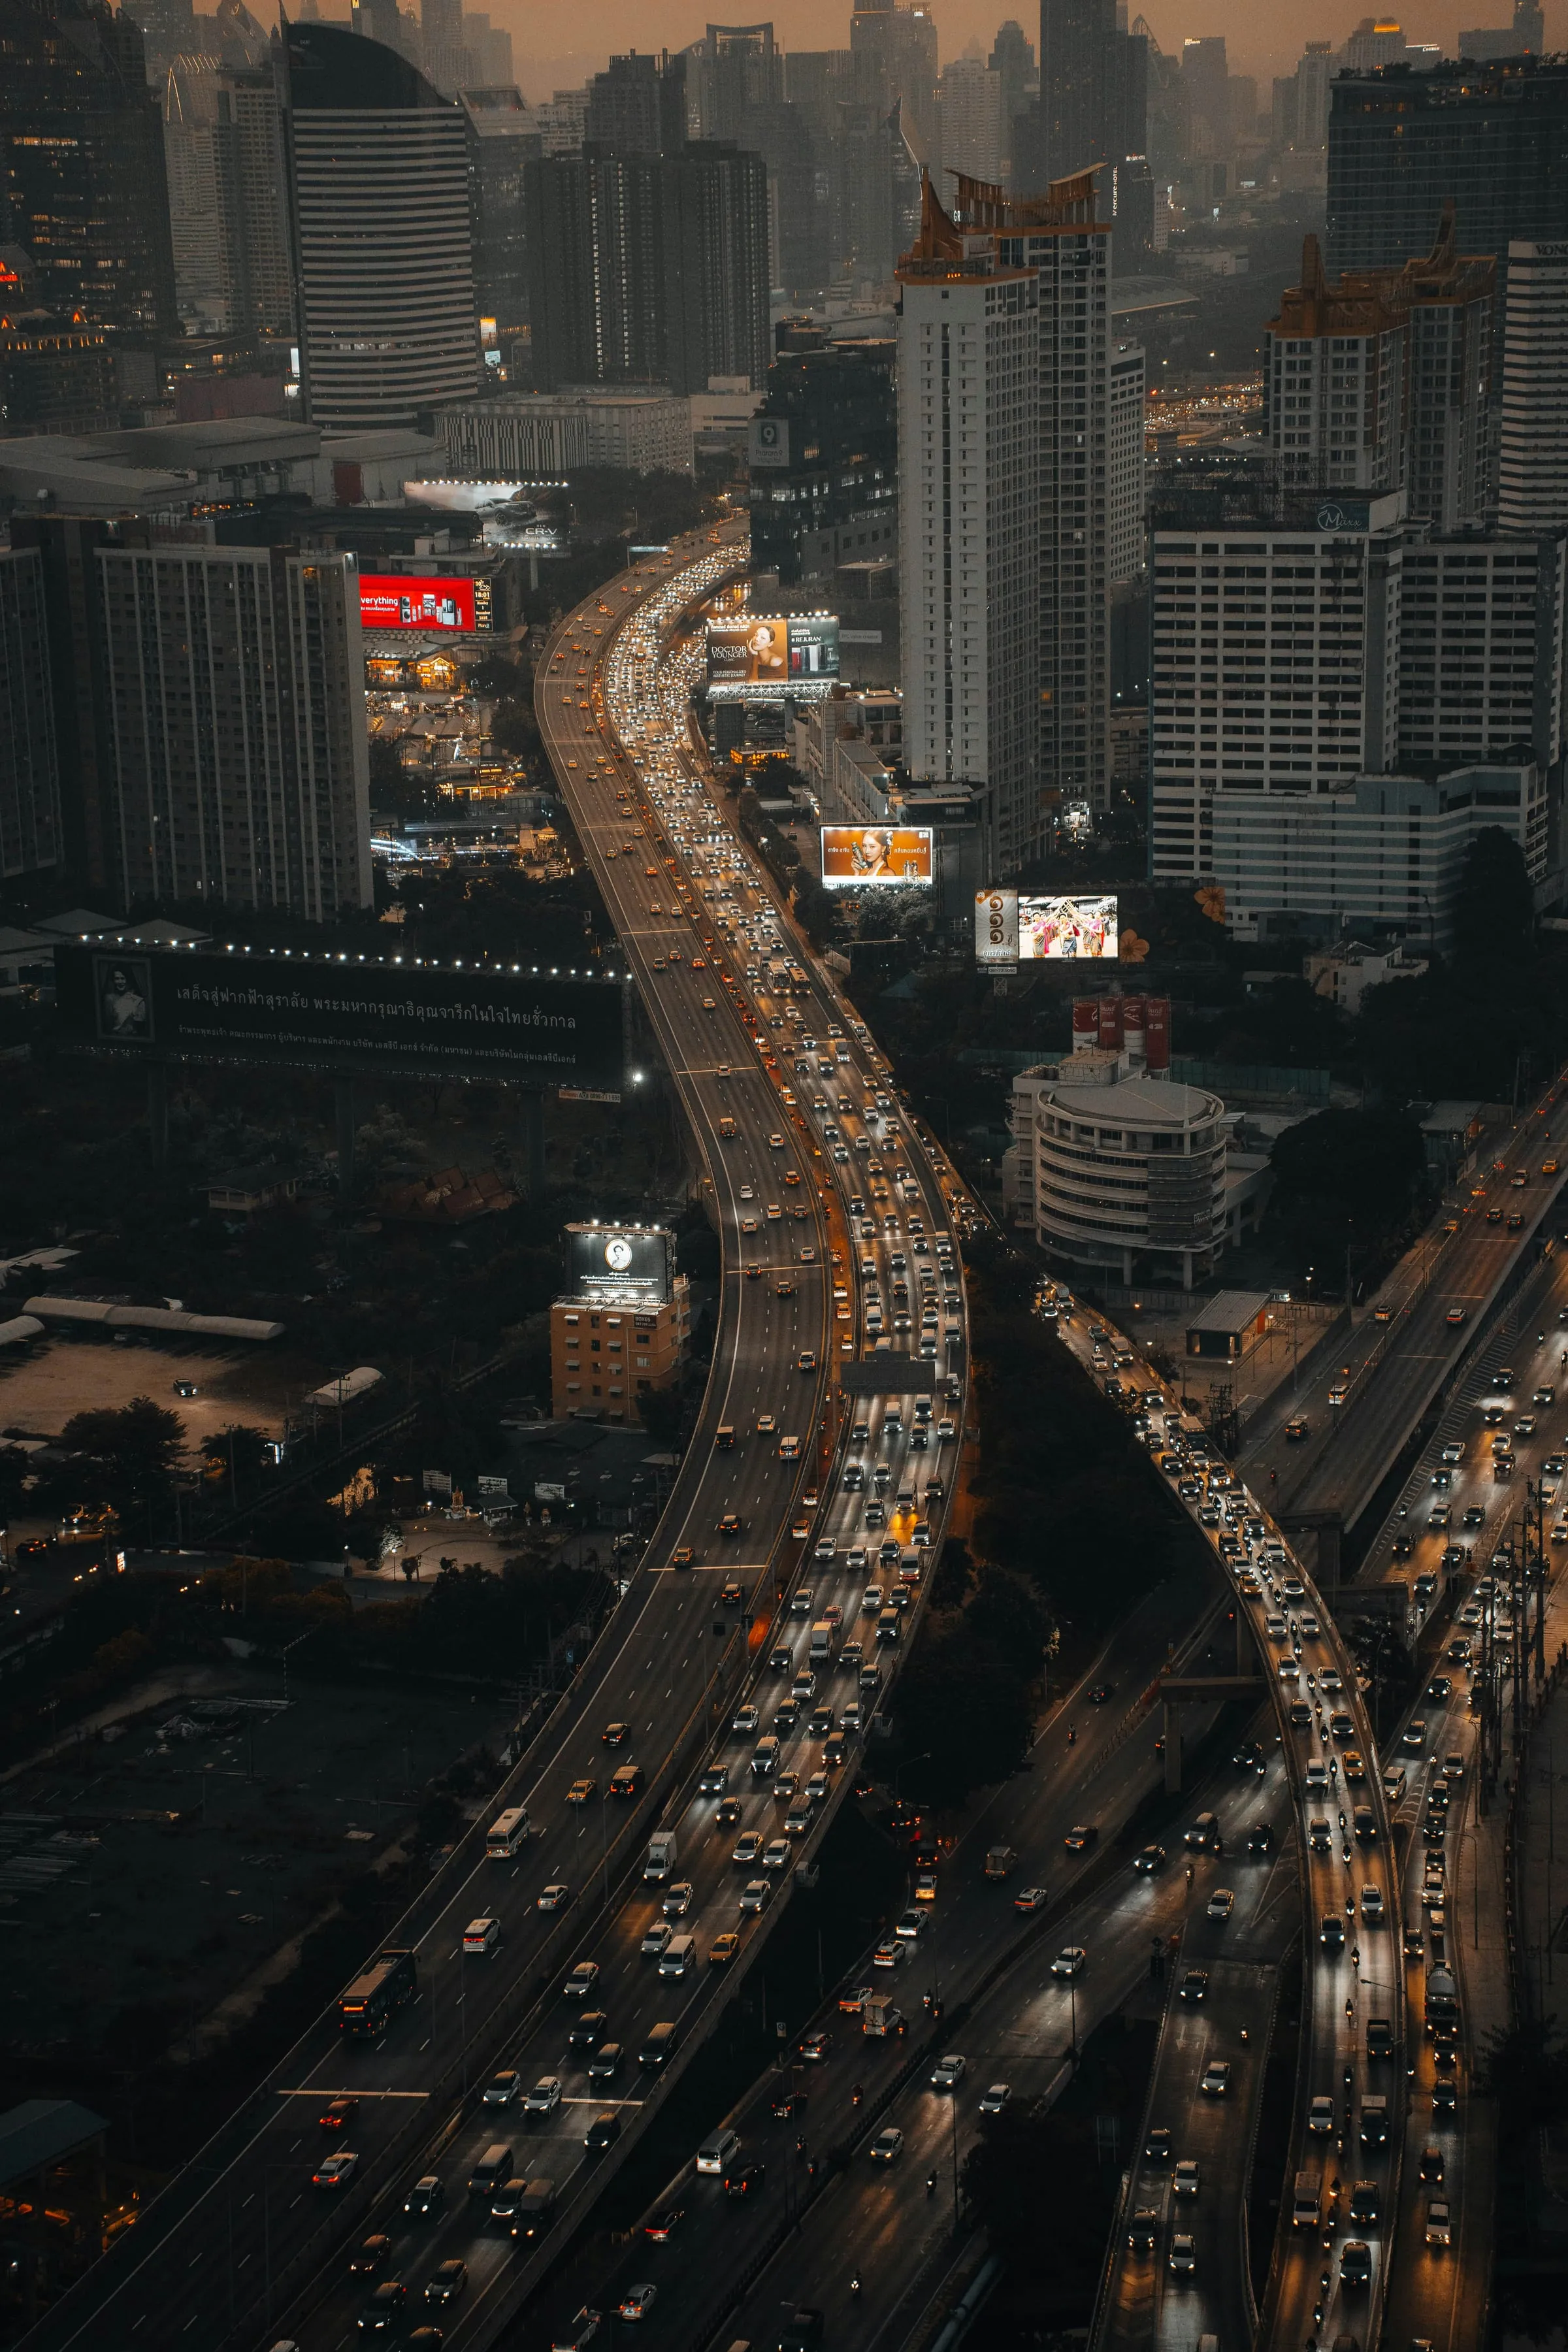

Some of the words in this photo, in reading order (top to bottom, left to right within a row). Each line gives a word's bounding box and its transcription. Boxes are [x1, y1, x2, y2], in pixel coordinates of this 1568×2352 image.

[763, 426, 775, 443] 9
[177, 983, 308, 1011] เสด็จสู่ฟากฟ้าสุราลัย
